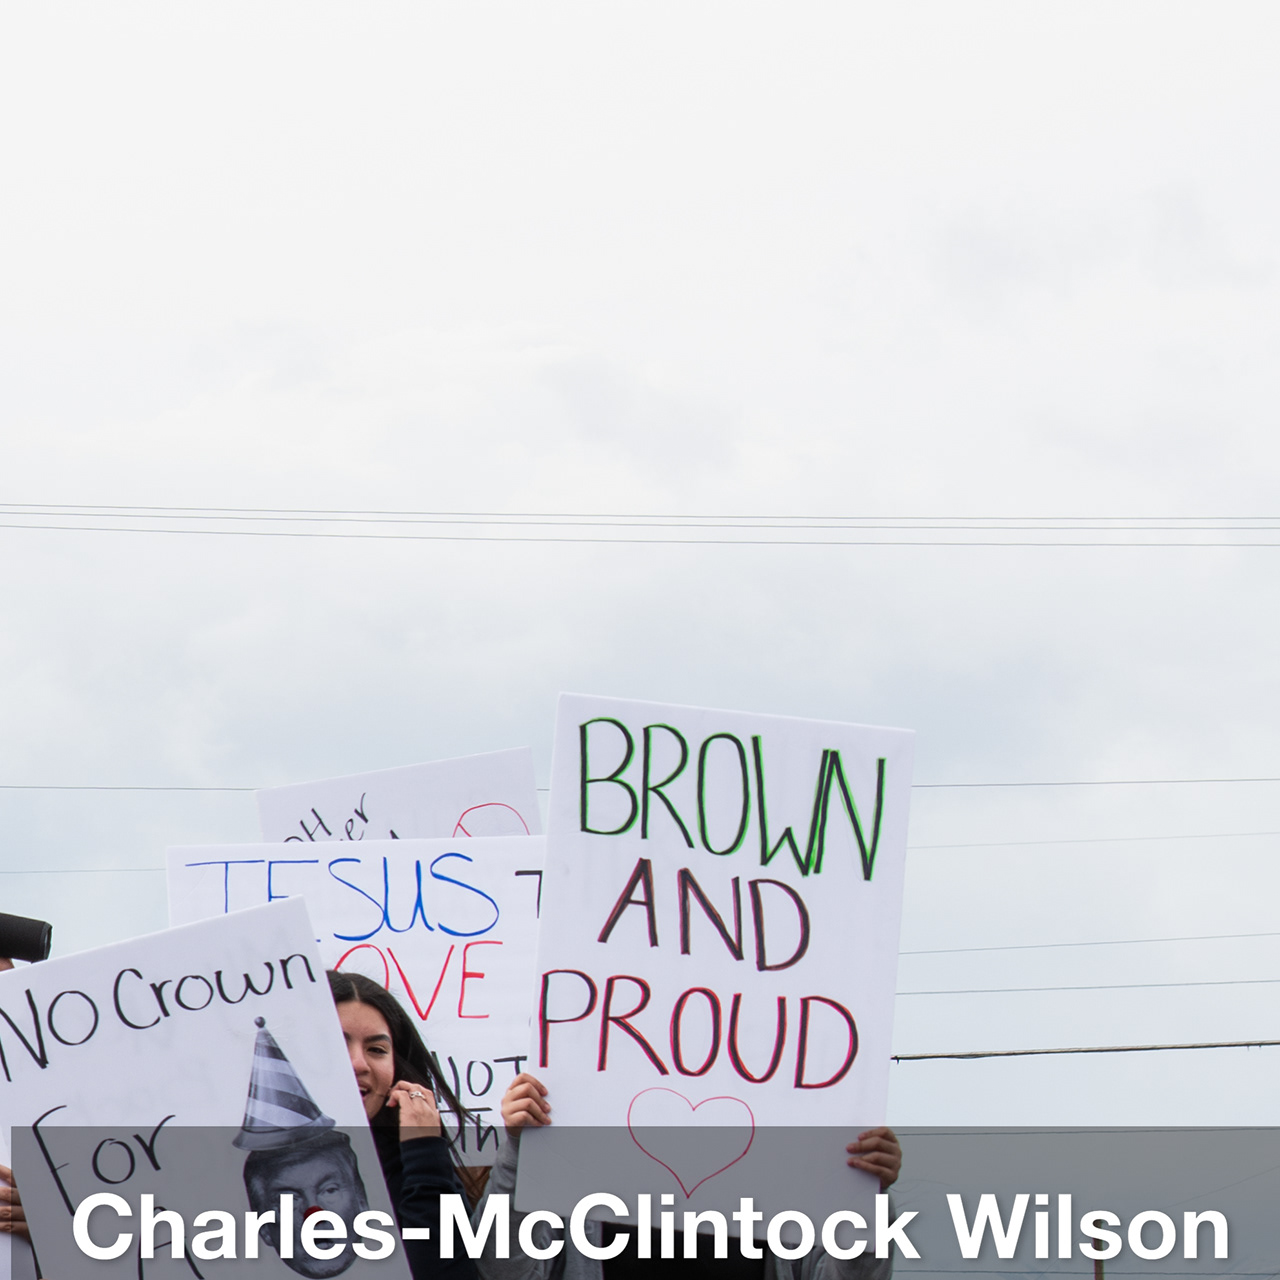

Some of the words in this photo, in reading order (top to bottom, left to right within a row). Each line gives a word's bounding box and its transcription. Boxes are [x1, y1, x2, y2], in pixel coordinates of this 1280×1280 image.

[578, 717, 886, 882] BROWN
[598, 858, 810, 972] AND
[114, 952, 316, 1030] Crown
[540, 969, 860, 1089] PROUD
[31, 1104, 176, 1216] For
